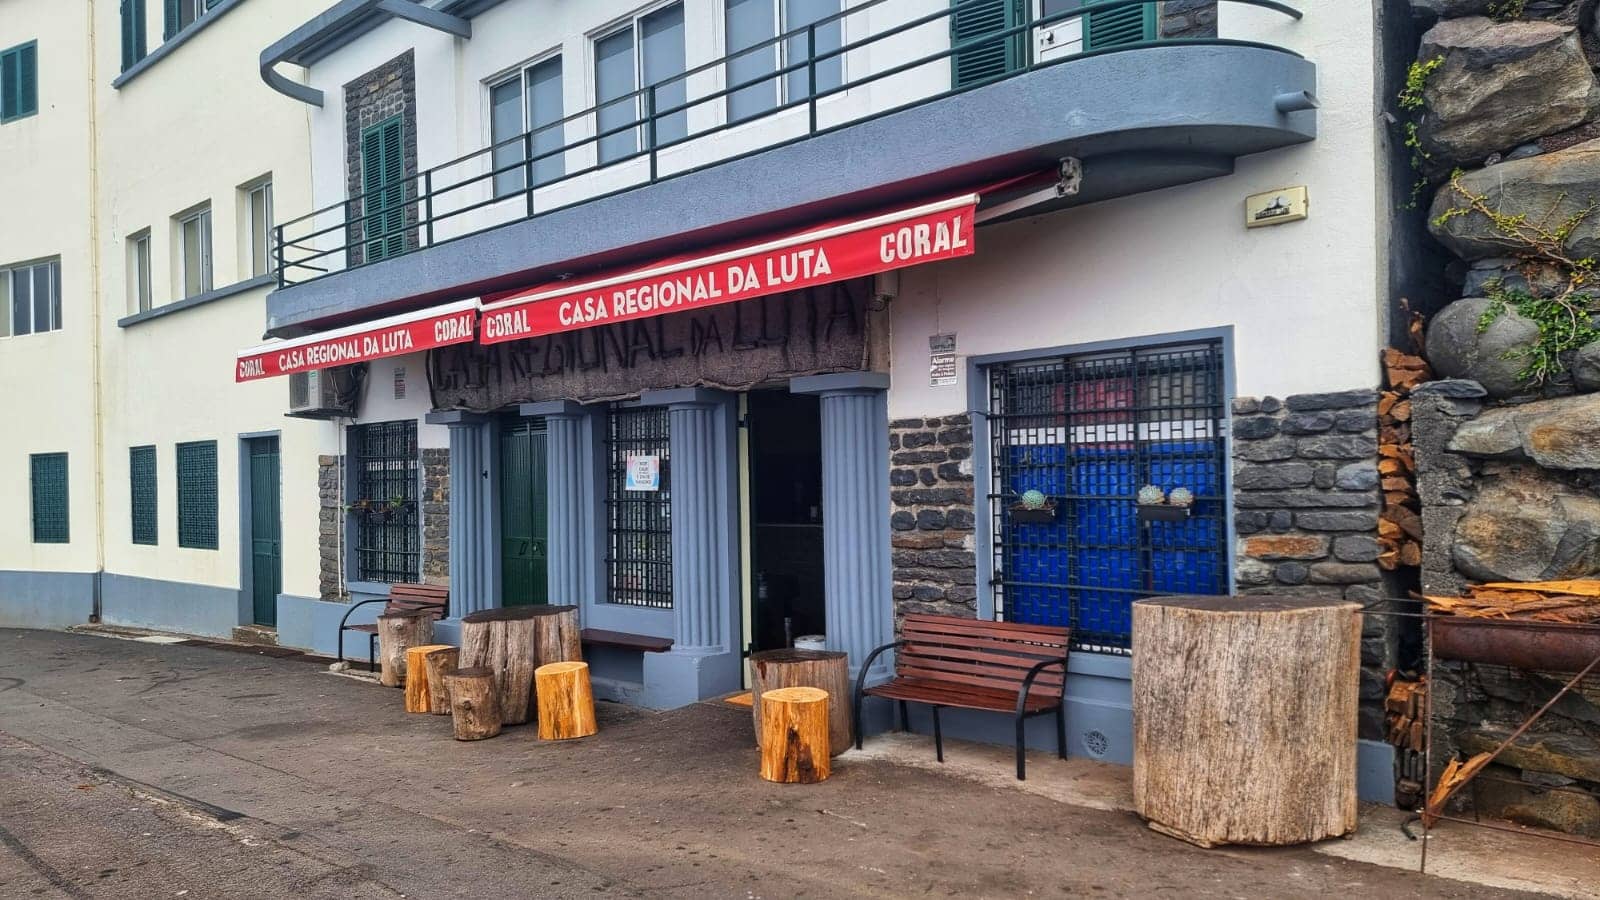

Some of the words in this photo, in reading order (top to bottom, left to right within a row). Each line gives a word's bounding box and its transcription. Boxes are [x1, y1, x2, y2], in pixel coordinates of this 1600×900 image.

[485, 309, 532, 340] CORAL
[558, 295, 609, 325] CASA
[613, 271, 722, 317] REGIONAL
[728, 263, 761, 294] DA
[767, 247, 832, 288] LUTA
[880, 215, 967, 264] CORAL
[239, 358, 266, 378] CORAL
[278, 350, 305, 372] CASA
[307, 337, 362, 366] REGIONAL
[363, 337, 380, 356] DA
[382, 329, 414, 353] LUTA
[434, 314, 473, 343] CORAL
[691, 314, 723, 357] DA
